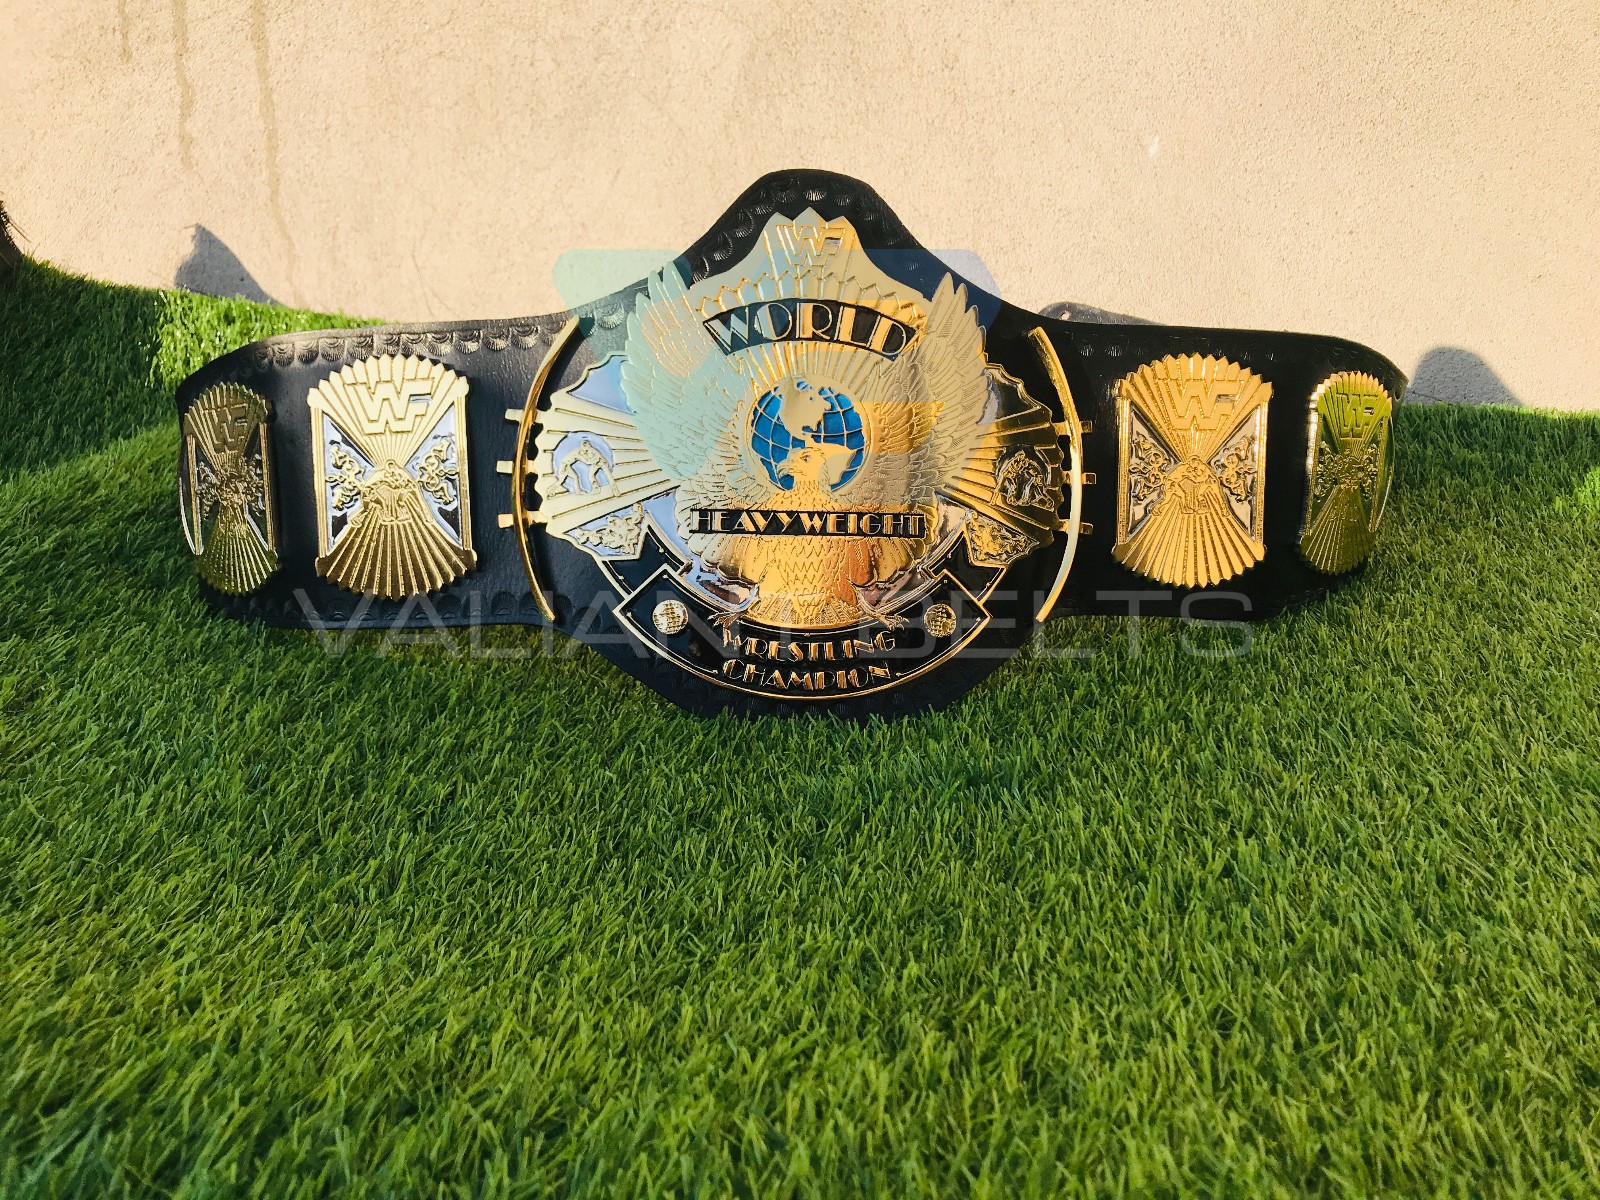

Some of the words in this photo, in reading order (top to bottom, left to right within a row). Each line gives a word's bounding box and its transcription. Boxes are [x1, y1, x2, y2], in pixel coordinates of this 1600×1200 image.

[704, 302, 907, 356] WORLD
[691, 509, 925, 537] HEAVYWEIGHT
[722, 628, 896, 662] WRESTLING
[721, 658, 892, 691] CHAMPION
